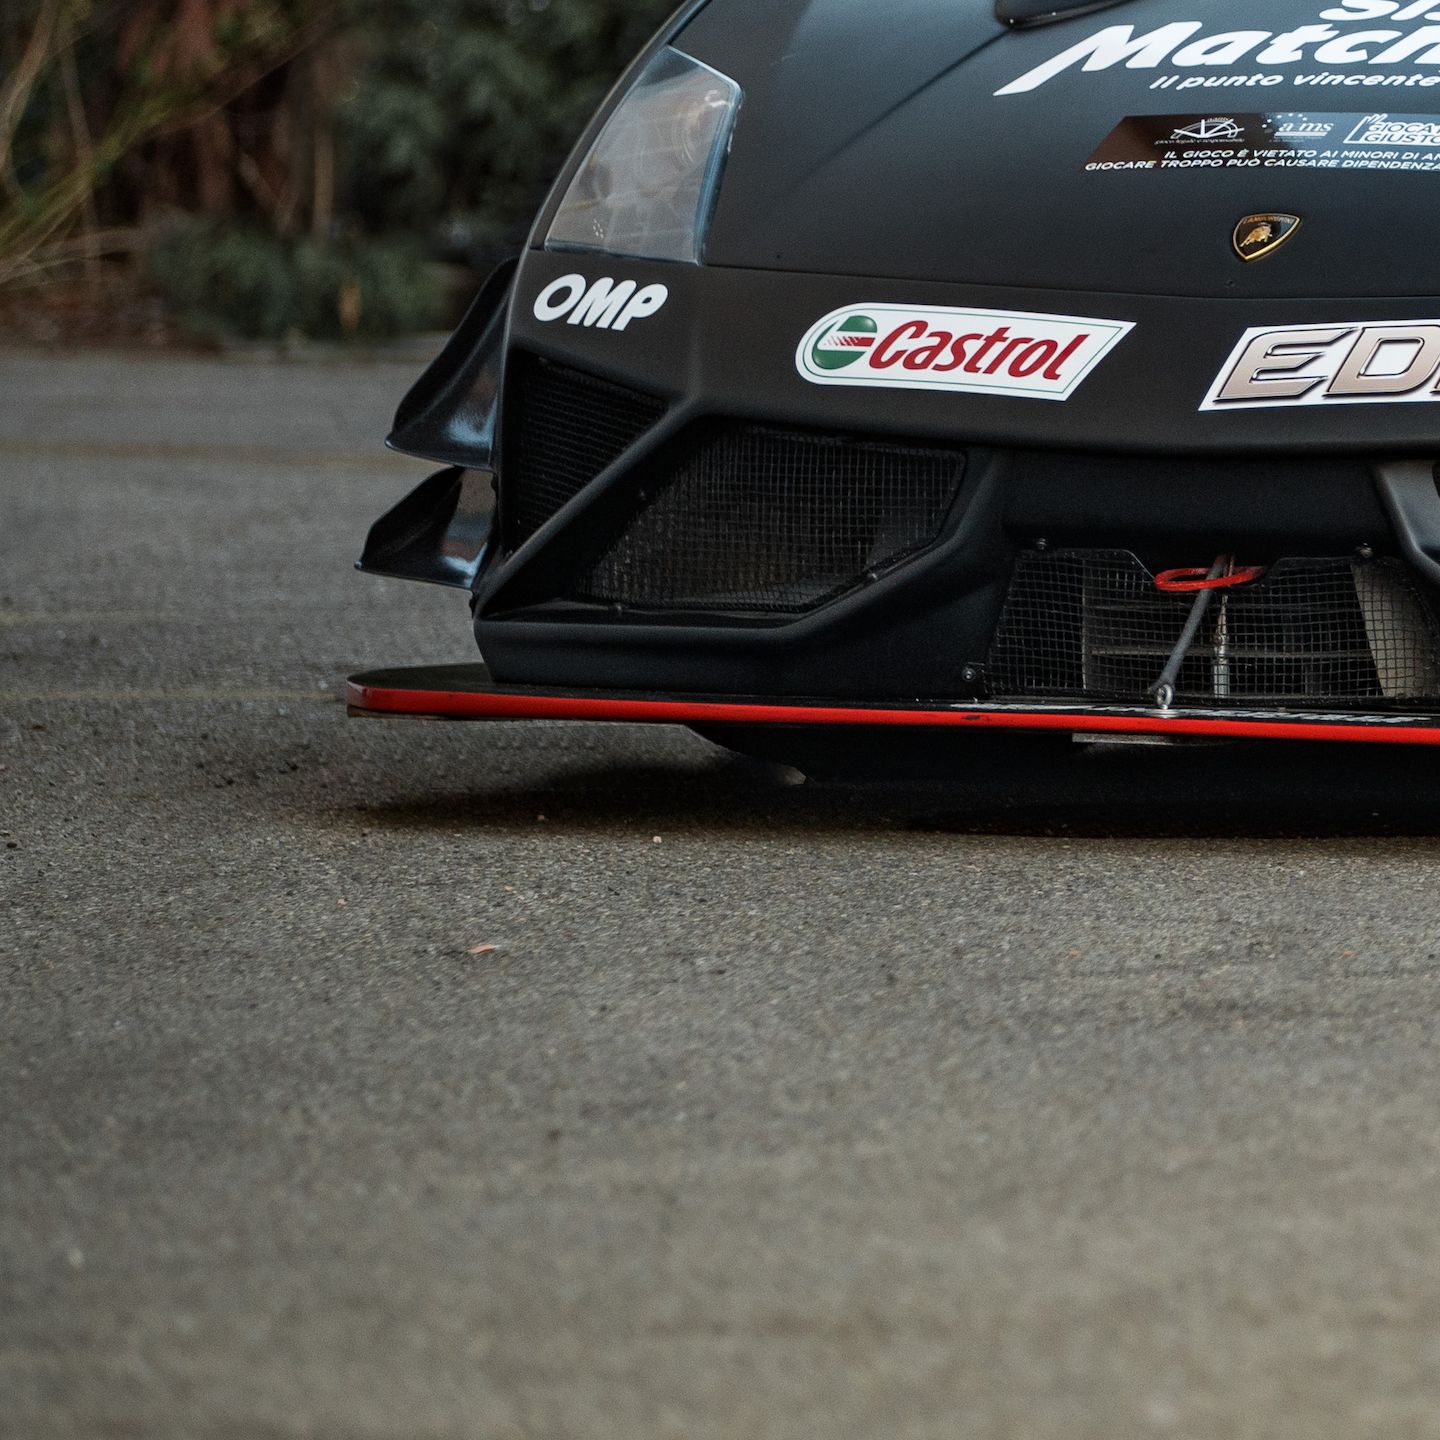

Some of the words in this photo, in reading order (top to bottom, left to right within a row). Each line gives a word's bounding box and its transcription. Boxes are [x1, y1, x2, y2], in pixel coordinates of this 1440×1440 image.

[1173, 72, 1284, 91] punto
[1084, 160, 1157, 172] GIOCARE
[1160, 159, 1224, 168] TROPPO
[1225, 156, 1261, 168] PUÒ
[1263, 158, 1341, 169] CAUSARE
[1163, 150, 1178, 159] IL
[1182, 149, 1235, 159] GIOCO
[1236, 148, 1250, 159] È
[1252, 149, 1318, 159] VIETATO
[1319, 149, 1340, 159] AI
[1339, 150, 1398, 161] MINORI
[1400, 152, 1420, 161] DI
[533, 273, 668, 332] OMP
[869, 319, 1089, 382] Castrol
